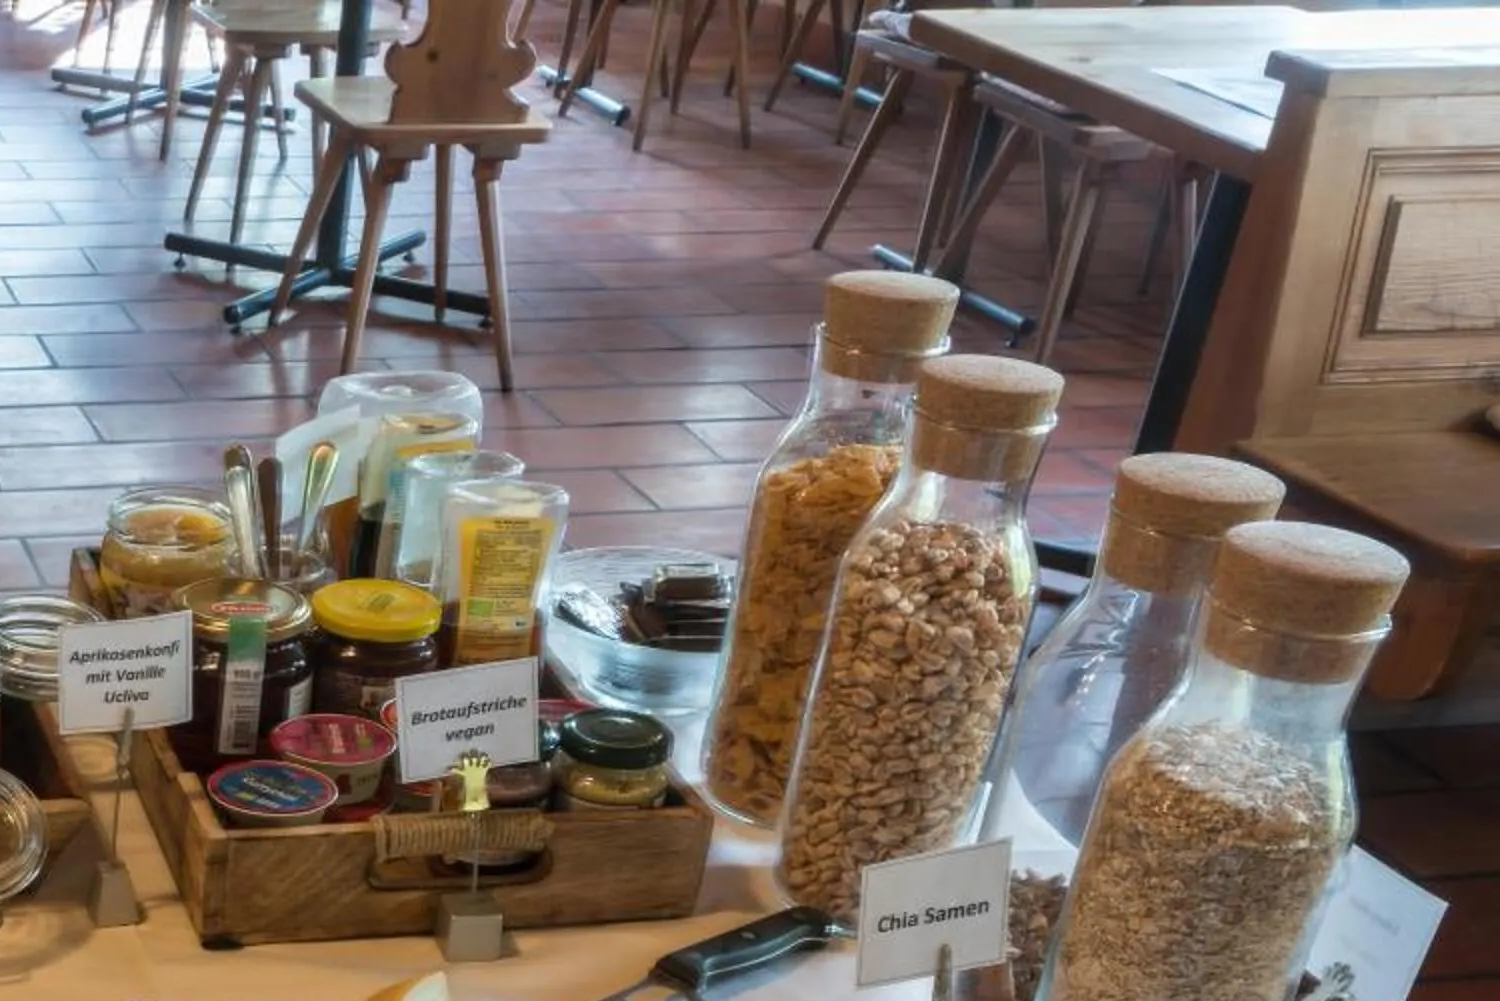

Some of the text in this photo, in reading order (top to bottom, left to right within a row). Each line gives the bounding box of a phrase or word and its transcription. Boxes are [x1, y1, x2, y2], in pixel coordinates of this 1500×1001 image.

[85, 665, 166, 684] mit Vanille
[411, 696, 527, 726] Brotaufstriche
[445, 723, 495, 742] vegan
[877, 900, 990, 933] Chia Samen
